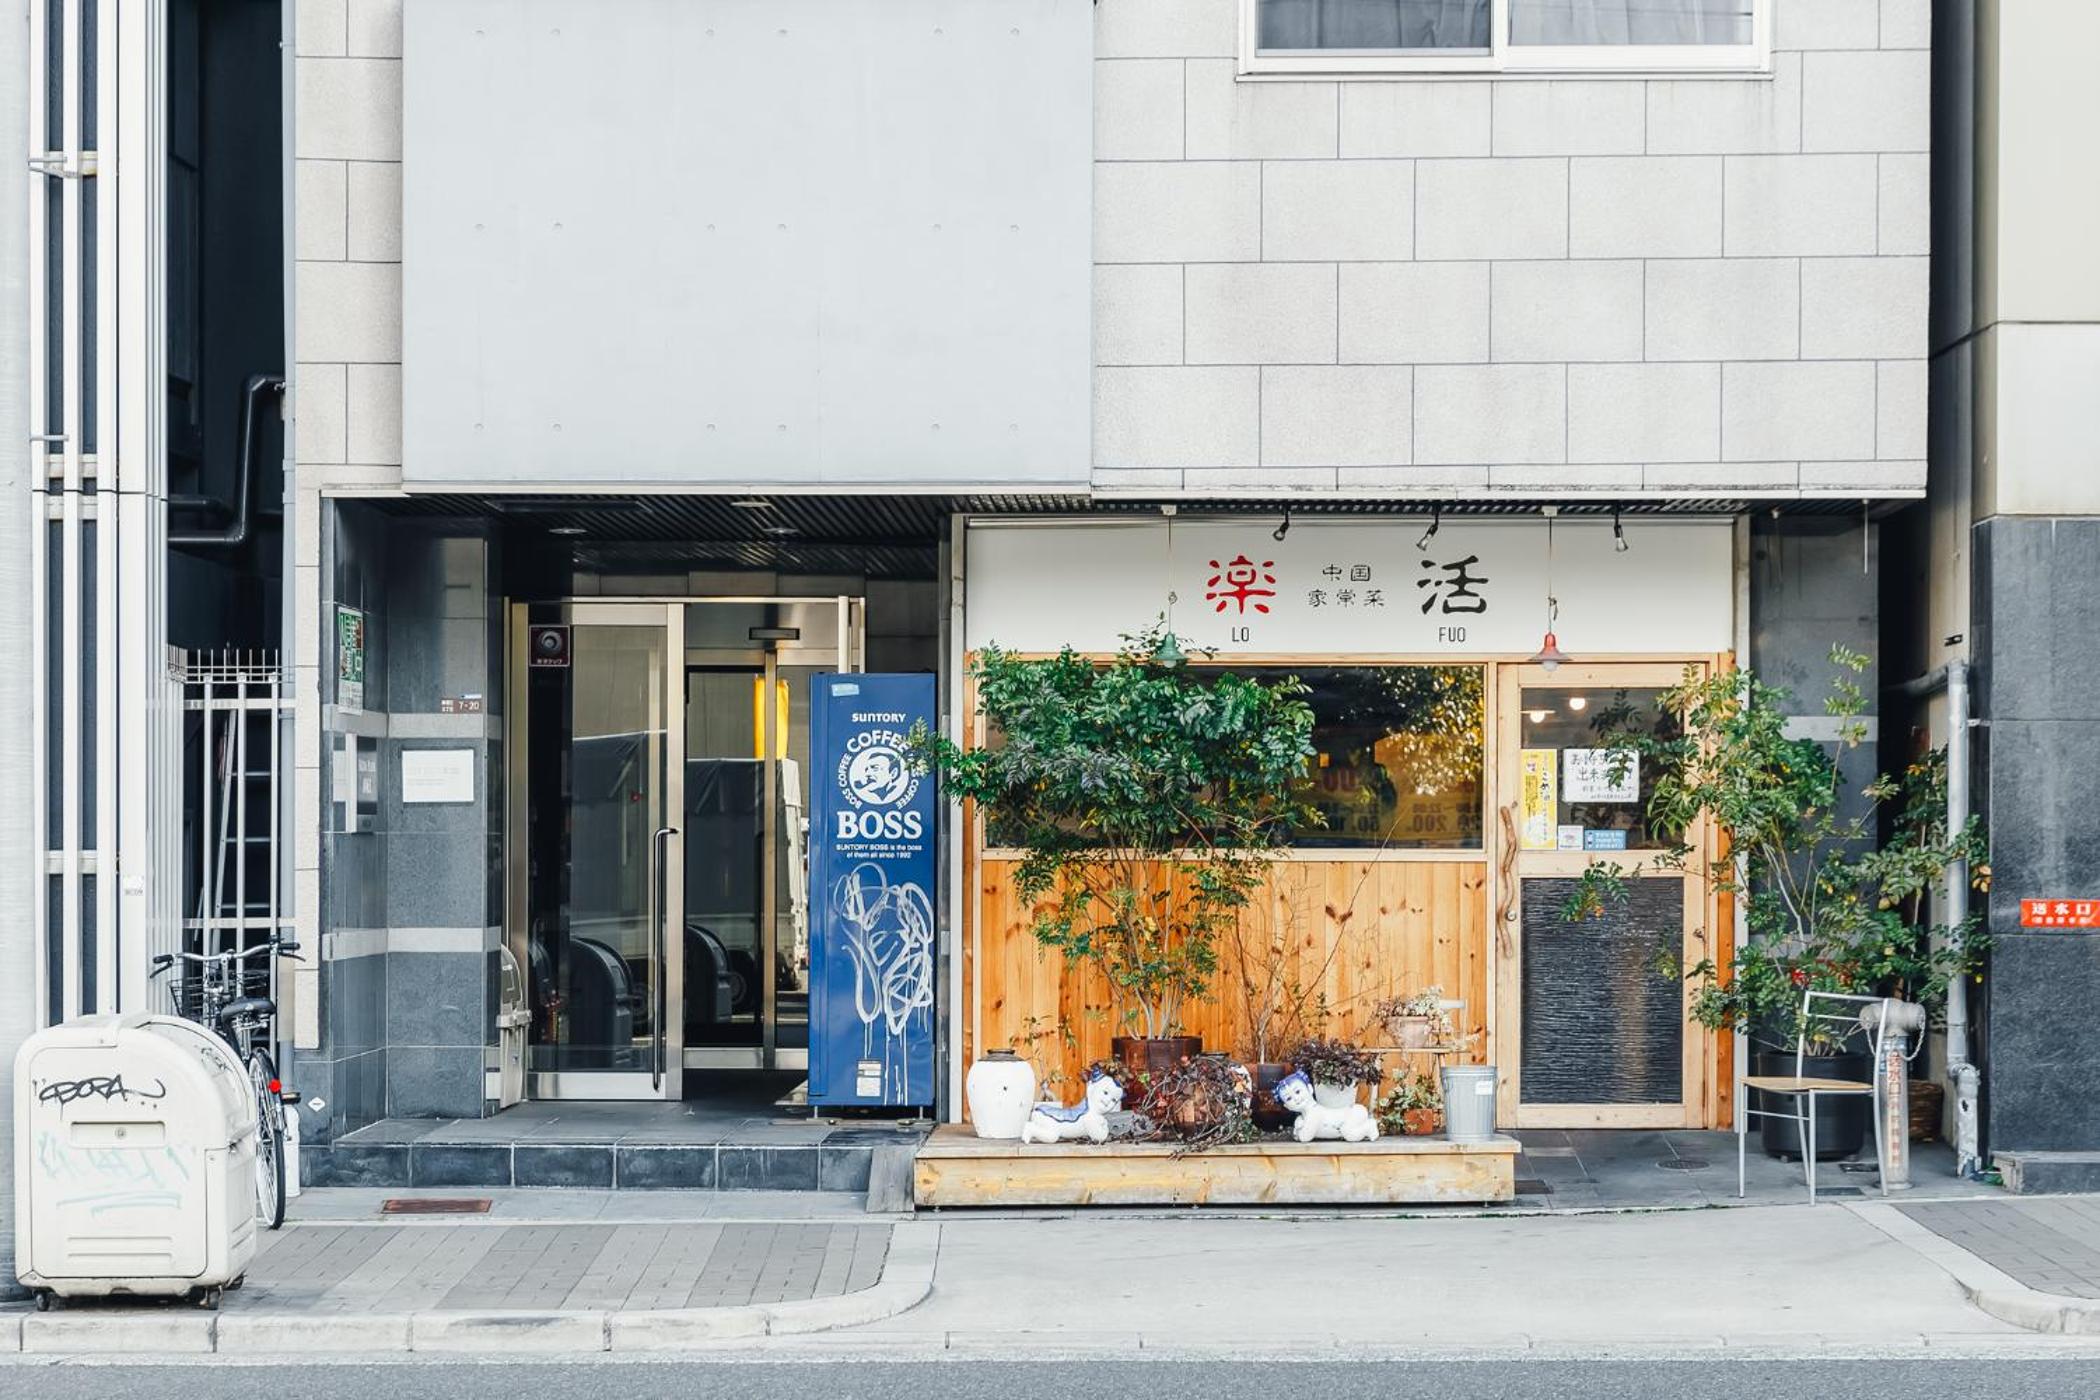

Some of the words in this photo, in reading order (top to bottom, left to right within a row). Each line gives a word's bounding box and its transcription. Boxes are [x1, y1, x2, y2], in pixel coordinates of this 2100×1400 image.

[1322, 564, 1371, 582] 中国
[1205, 552, 1276, 615] 楽
[1417, 555, 1489, 615] 活
[1307, 589, 1385, 608] 家常菜
[1231, 626, 1250, 642] LO
[1438, 626, 1467, 642] FUO
[836, 810, 923, 840] BOSS
